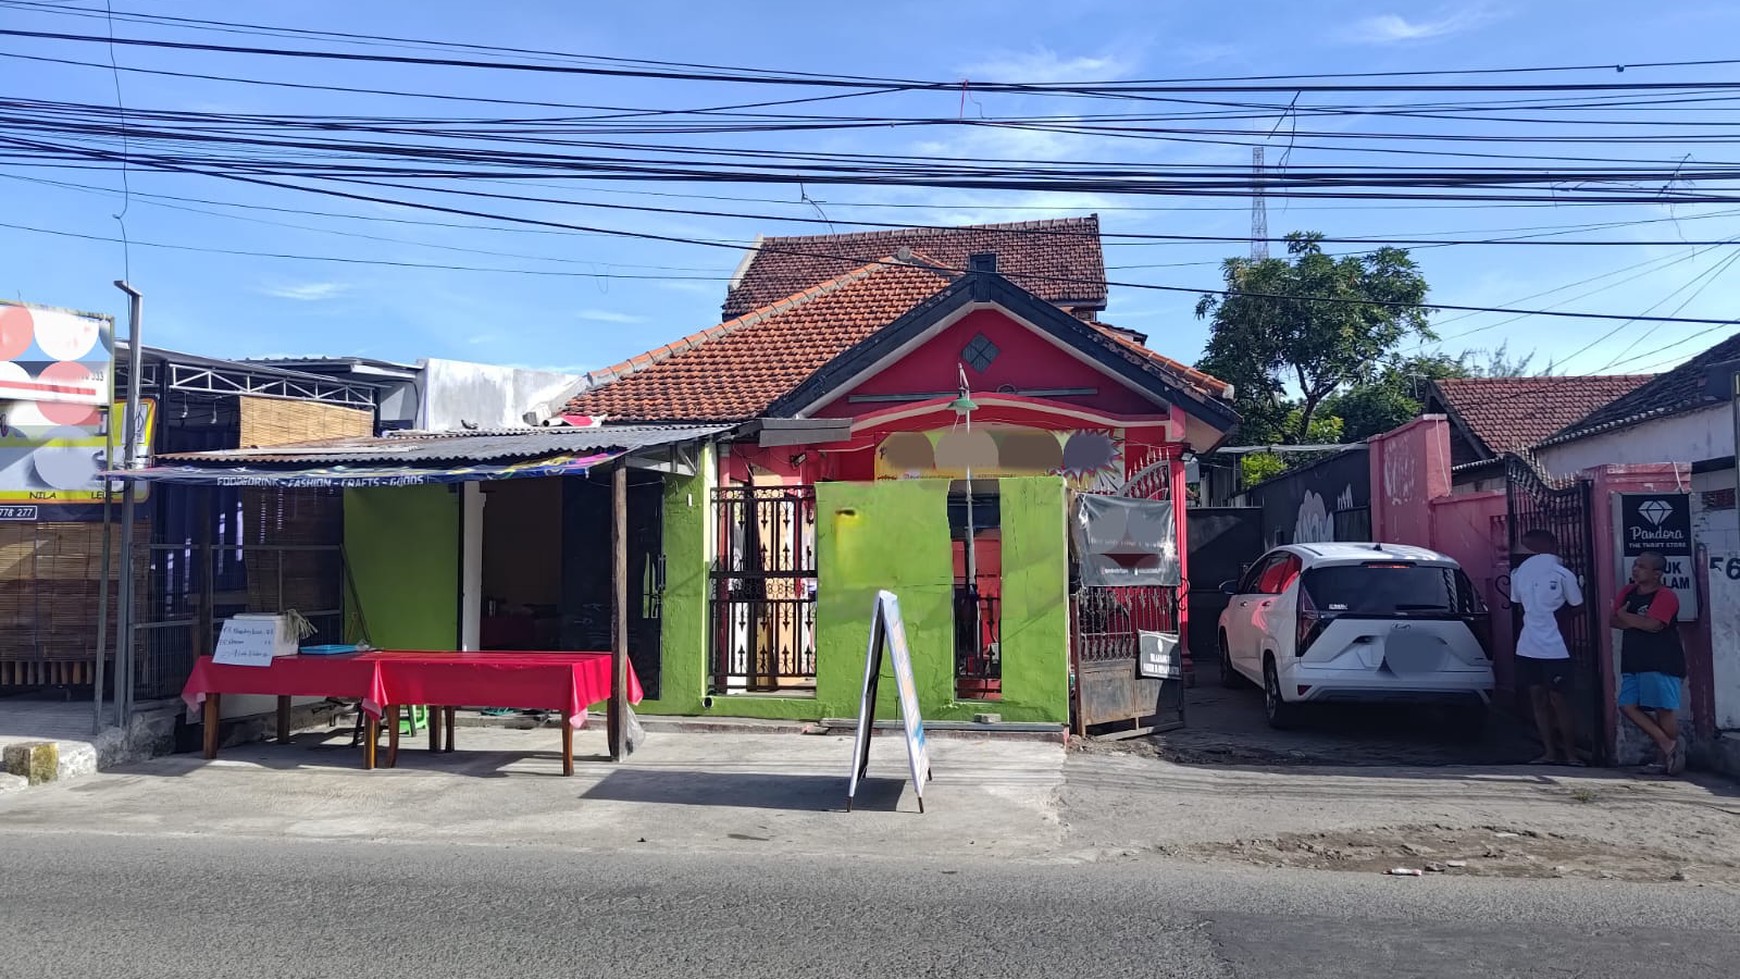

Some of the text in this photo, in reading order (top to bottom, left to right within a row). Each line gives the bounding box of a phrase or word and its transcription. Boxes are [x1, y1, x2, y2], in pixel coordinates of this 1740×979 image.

[287, 479, 331, 487] FASHION
[390, 475, 424, 487] GOODS
[29, 491, 57, 499] NILA
[16, 508, 33, 517] 277
[1629, 526, 1685, 541] Pandora
